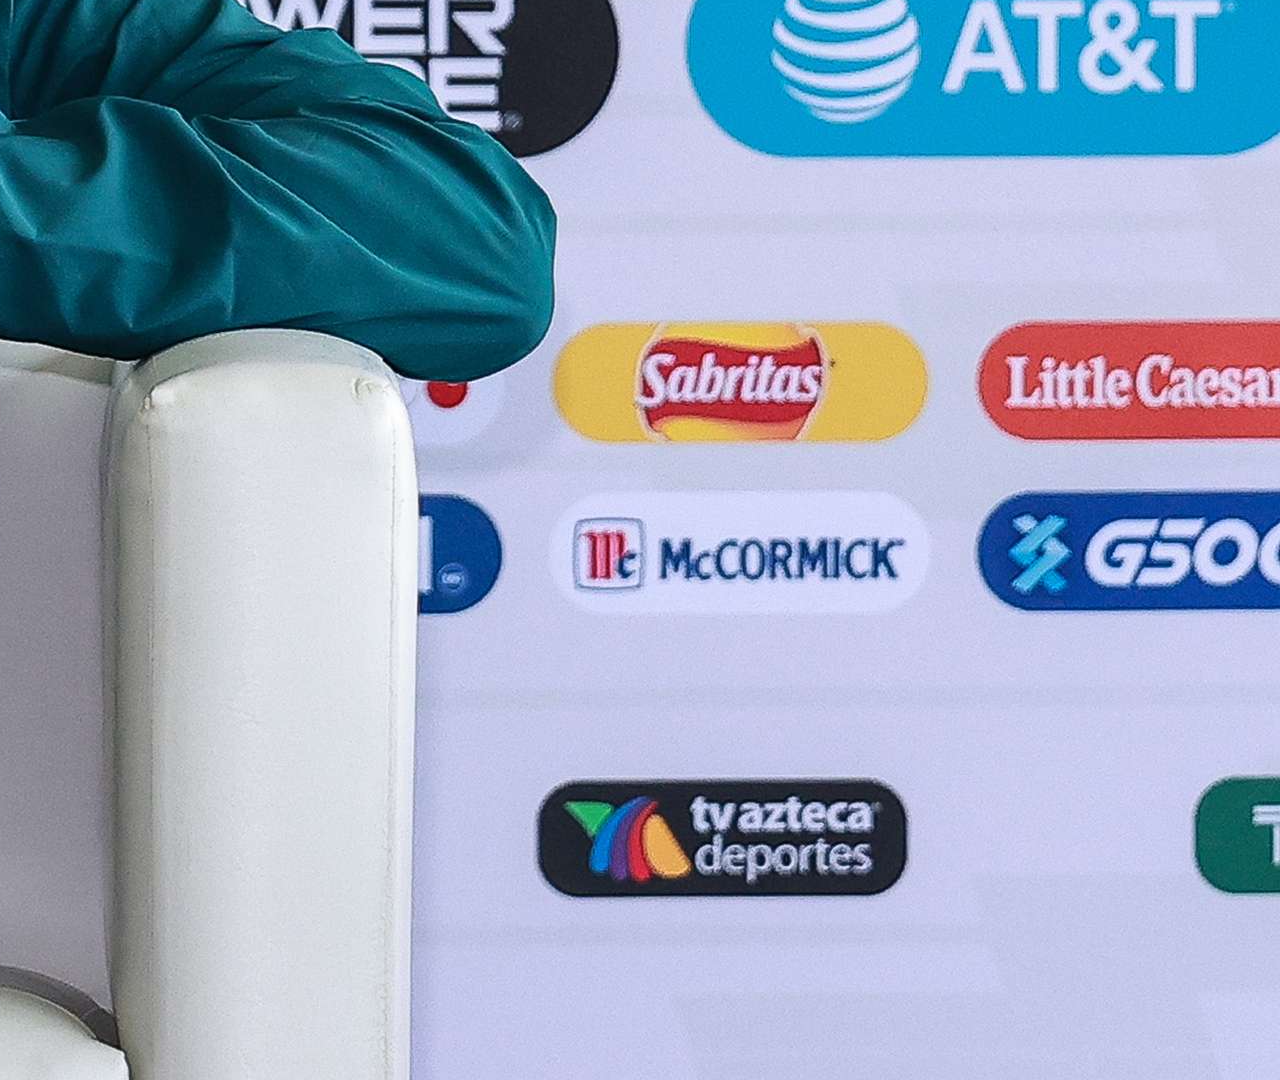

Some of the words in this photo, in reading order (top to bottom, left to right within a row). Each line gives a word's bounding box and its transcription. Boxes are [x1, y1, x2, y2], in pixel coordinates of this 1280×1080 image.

[637, 352, 825, 408] Sabritas
[1004, 354, 1133, 409] Little
[694, 834, 874, 885] deportes
